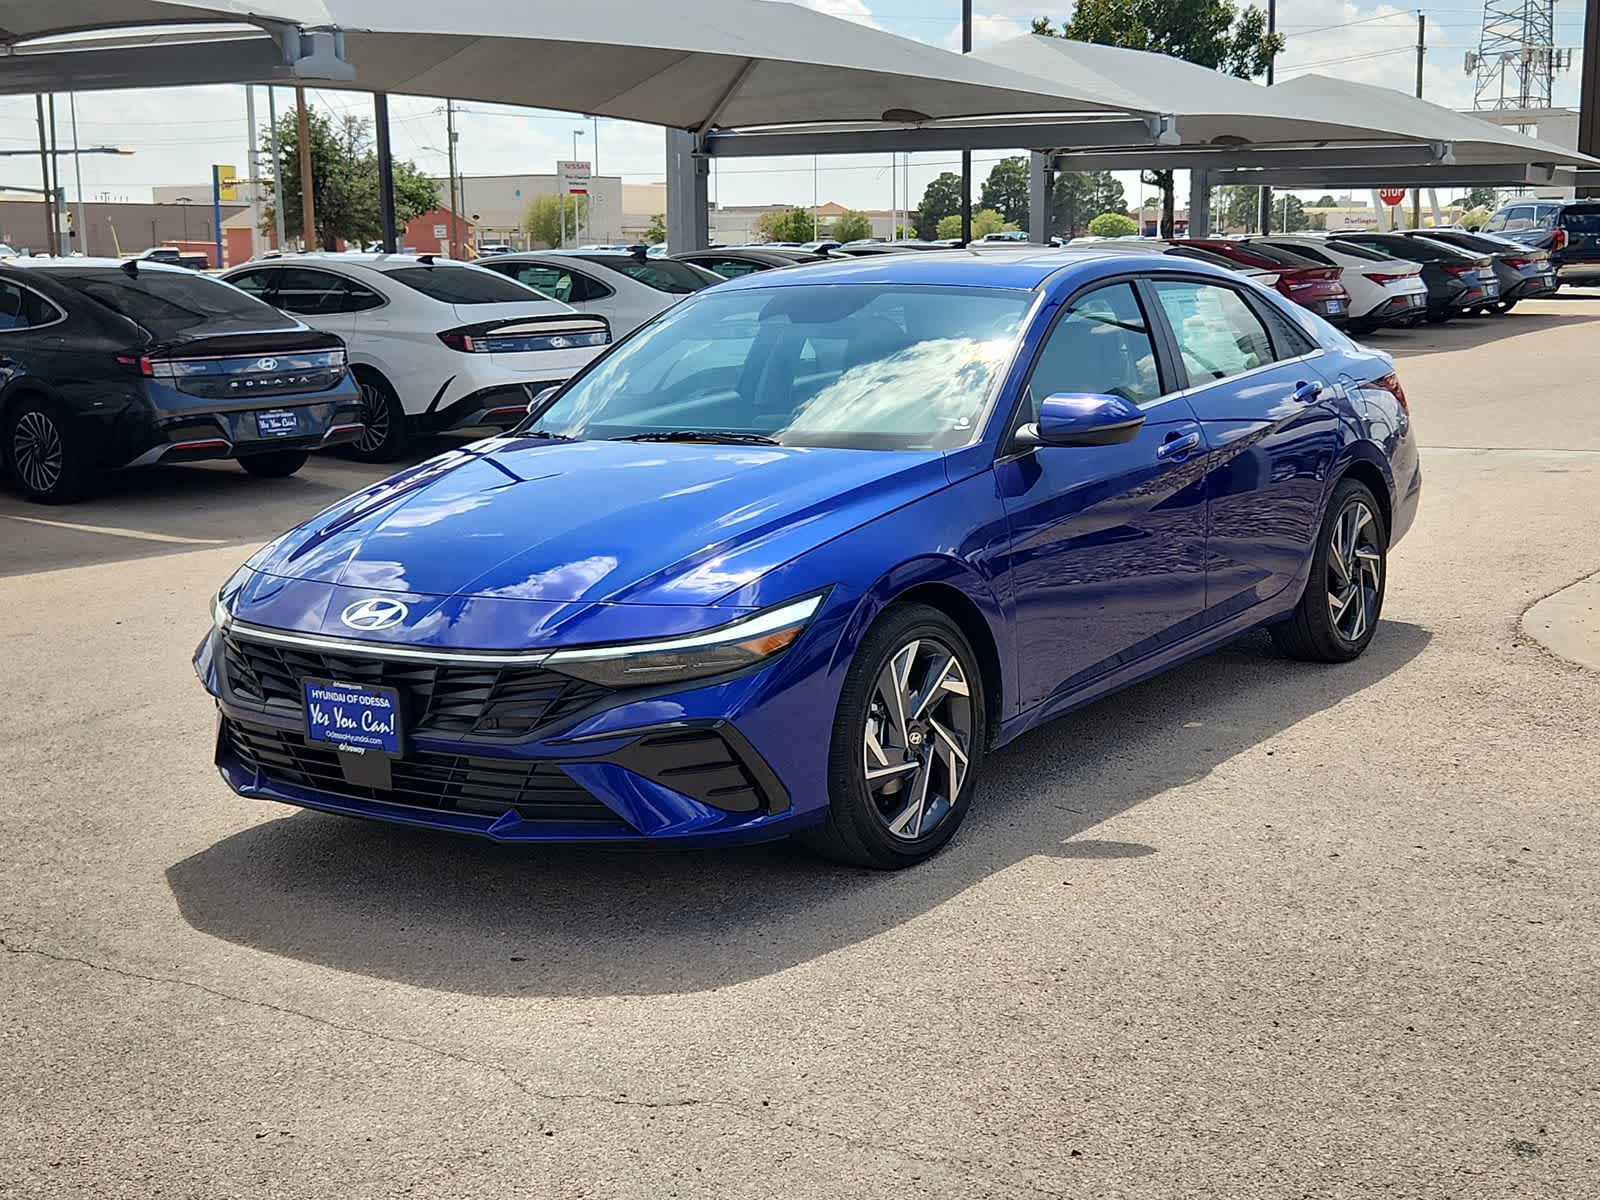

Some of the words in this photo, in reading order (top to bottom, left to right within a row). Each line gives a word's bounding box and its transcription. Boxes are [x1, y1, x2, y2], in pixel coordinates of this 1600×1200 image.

[1381, 188, 1404, 198] STOP
[230, 376, 309, 387] SONATA
[311, 689, 346, 703] HYUNDAI
[346, 694, 359, 704] OF
[359, 695, 391, 708] ODESSA
[310, 703, 331, 726] Yes
[333, 706, 358, 729] You
[361, 710, 395, 736] Can!
